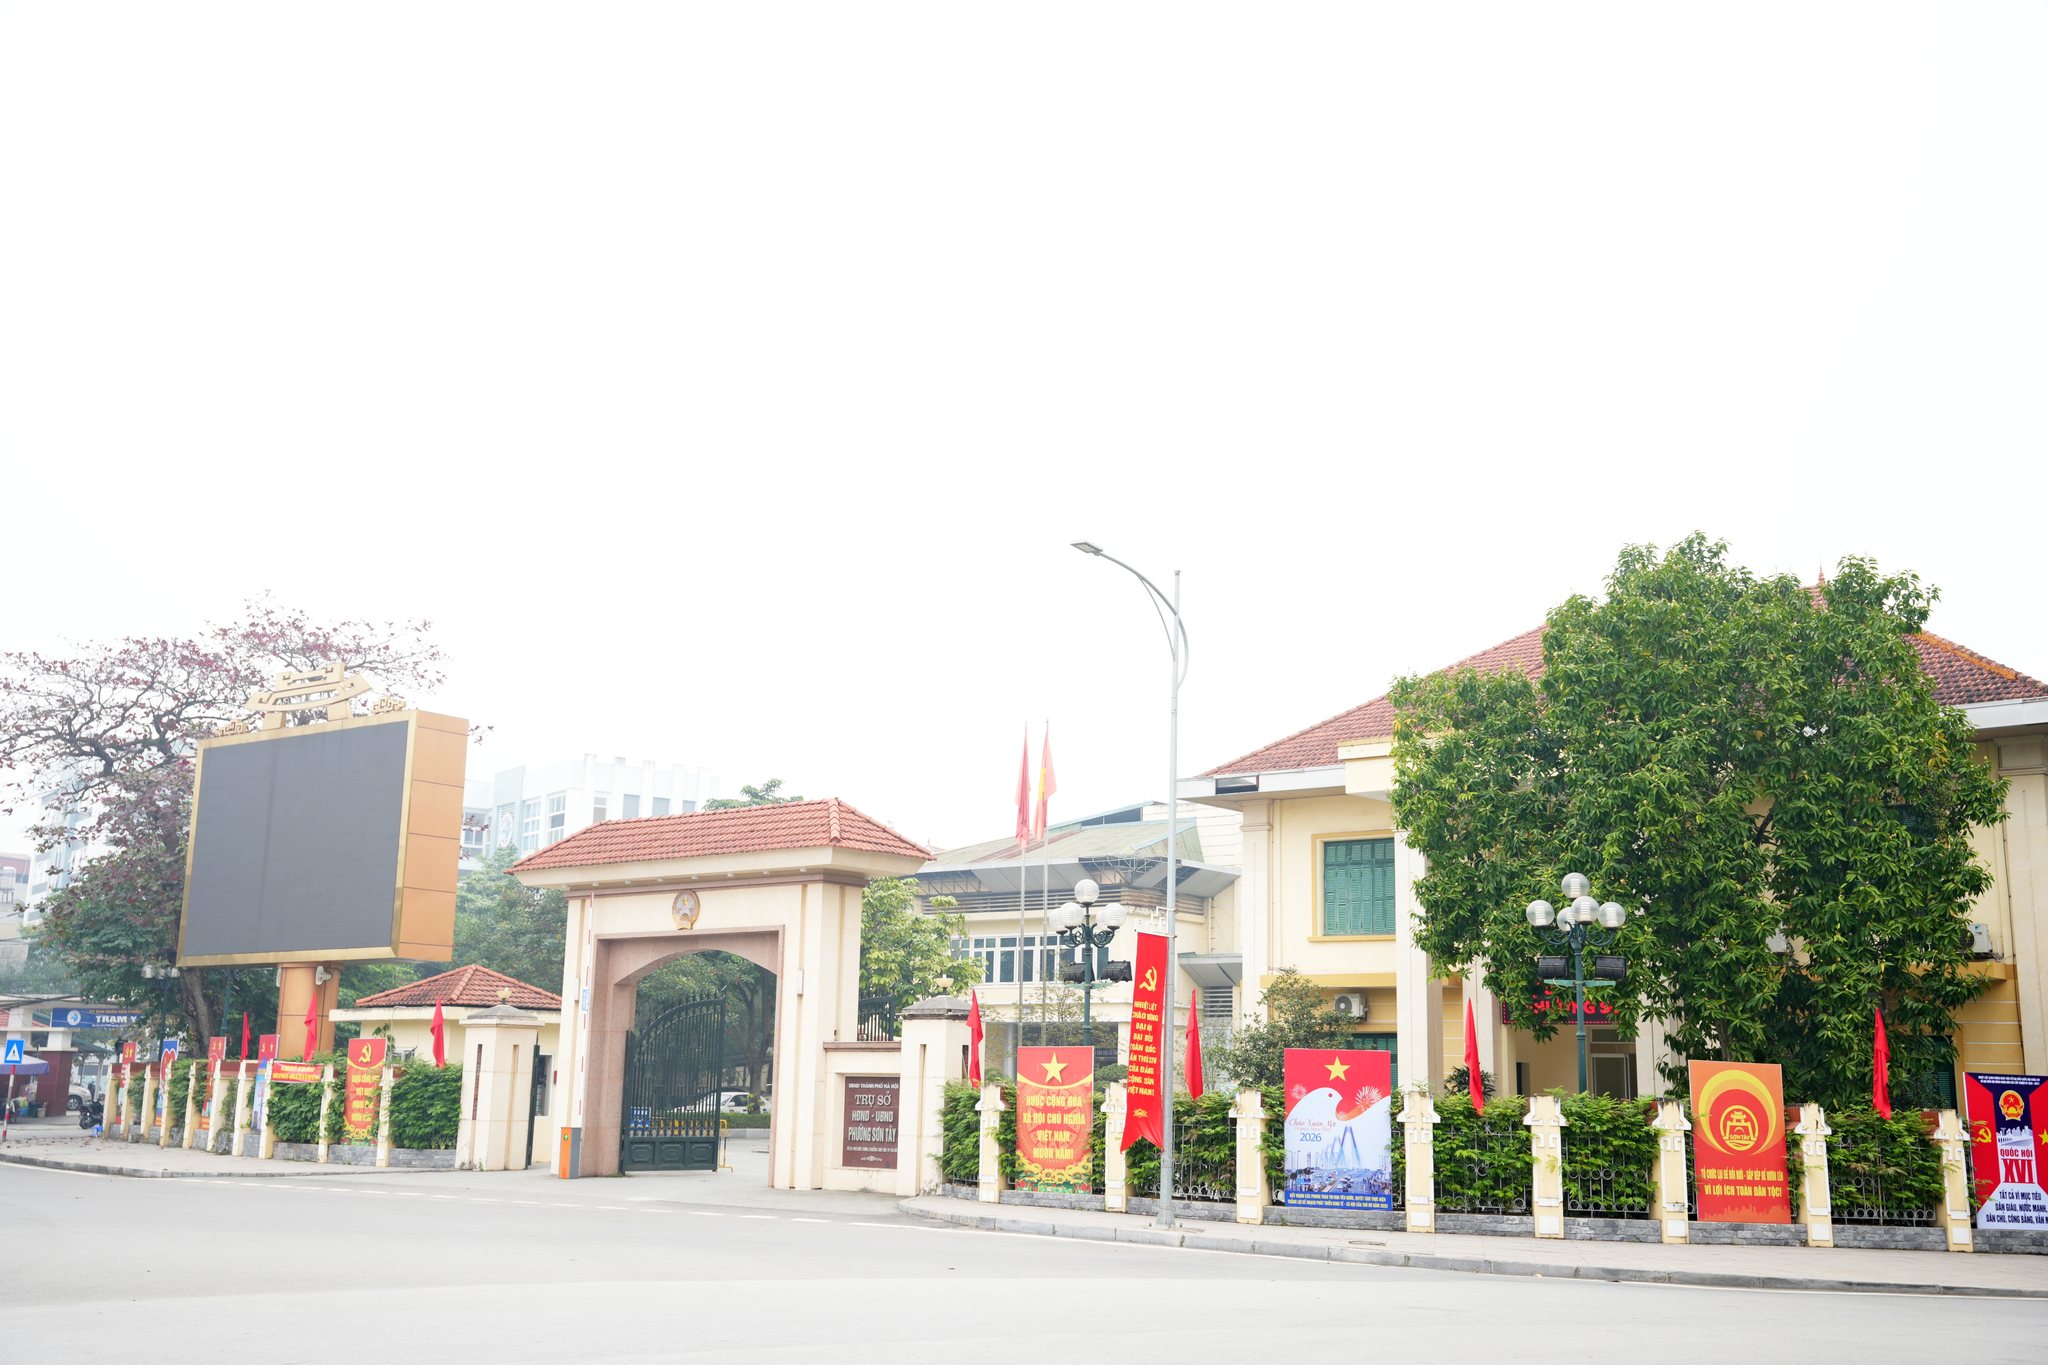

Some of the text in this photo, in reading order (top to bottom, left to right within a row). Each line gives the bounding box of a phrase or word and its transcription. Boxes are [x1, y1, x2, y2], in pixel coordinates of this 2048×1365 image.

[95, 1016, 127, 1024] TRẠM
[855, 1091, 891, 1107] TRỤ SỞ
[1026, 1095, 1044, 1106] NƯỚC
[1046, 1095, 1065, 1108] CỘNG
[852, 1110, 869, 1121] HĐND
[876, 1111, 893, 1122] UBND
[1023, 1112, 1086, 1124] XÃ HỘI CHỦ NGHĨA
[848, 1124, 896, 1143] PHƯỜNG SƠN TÂY
[1037, 1129, 1070, 1142] VIỆT NAM
[1300, 1133, 1321, 1142] 2026
[1033, 1147, 1053, 1159] MUÔN
[2000, 1146, 2033, 1159] QUỐC HỘI
[2001, 1158, 2035, 1184] XVI
[1705, 1183, 1782, 1199] VÌ LỢI ÍCH TOÀN DÂN TỘC!
[1999, 1188, 2041, 1203] TẤT CẢ VÌ MỤC TIÊU
[1995, 1202, 2047, 1213] DÂN GIÀU, NƯỚC MẠNH,
[1986, 1213, 1995, 1222] DÂN
[1997, 1211, 2007, 1224] CHỦ,
[2008, 1214, 2020, 1223] CÔNG
[2035, 1213, 2045, 1224] VĂN
